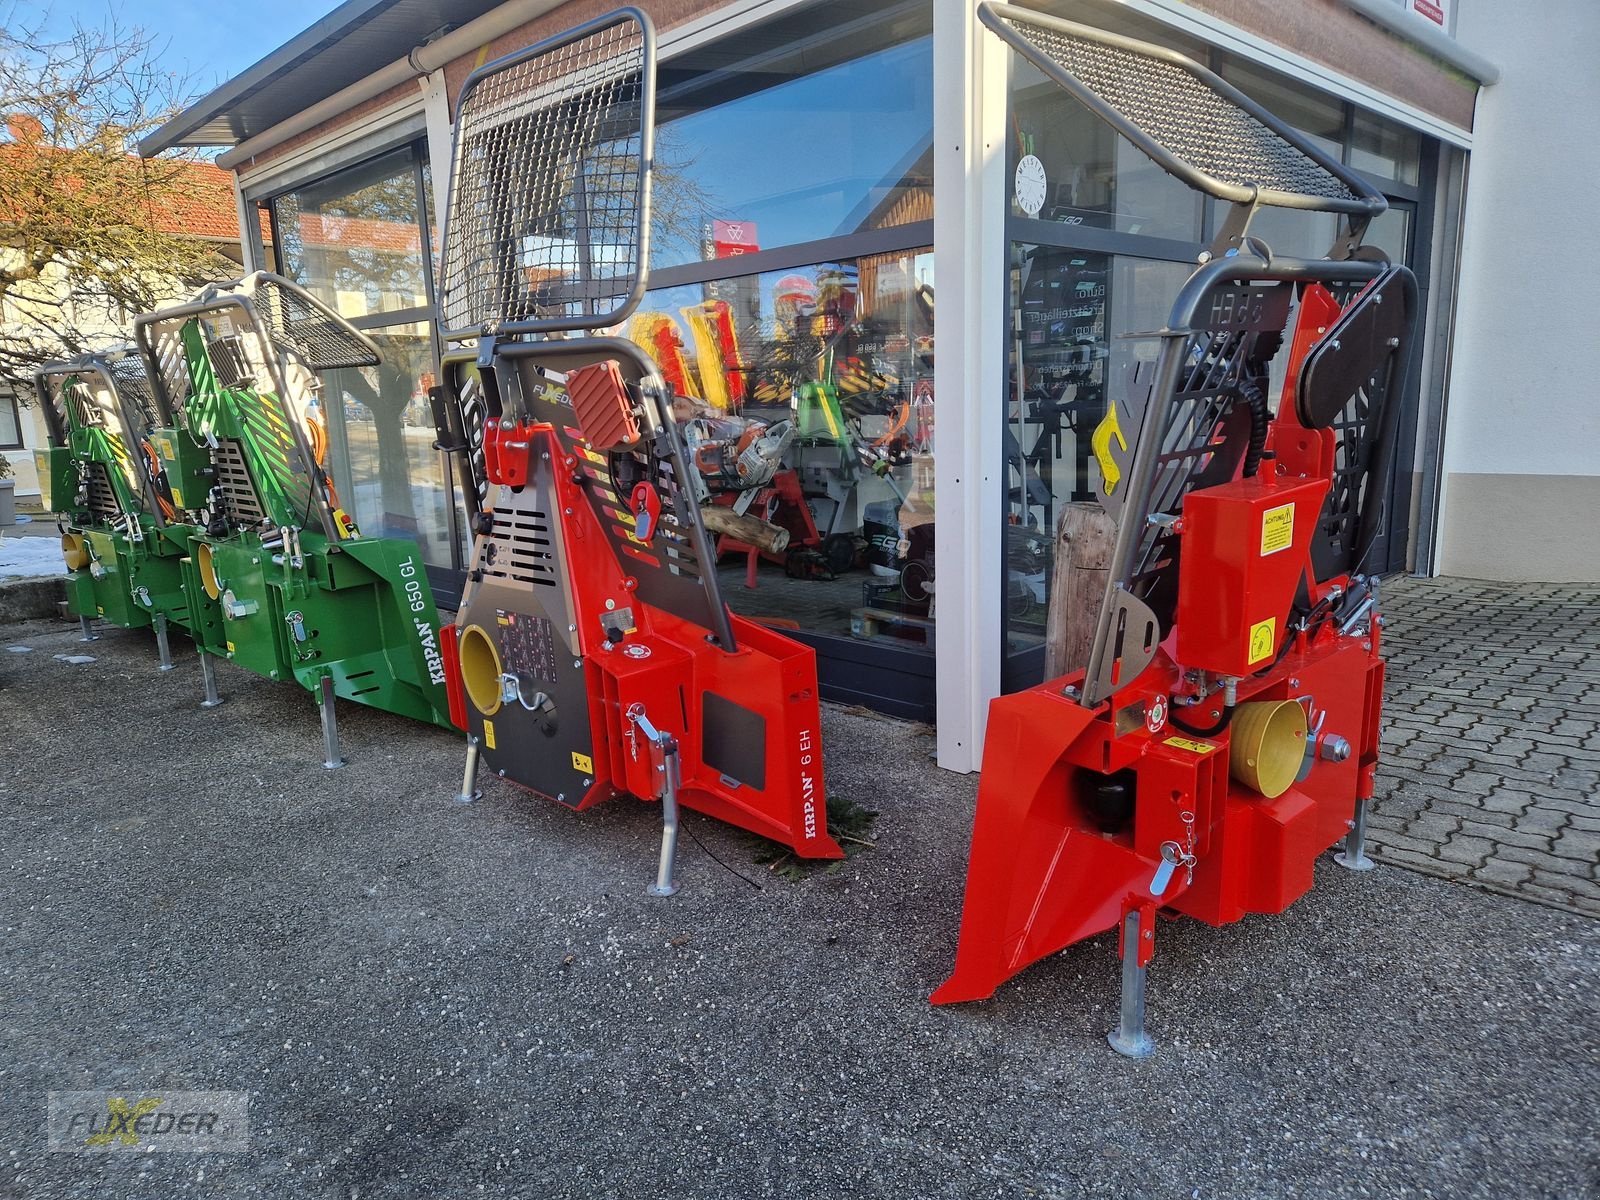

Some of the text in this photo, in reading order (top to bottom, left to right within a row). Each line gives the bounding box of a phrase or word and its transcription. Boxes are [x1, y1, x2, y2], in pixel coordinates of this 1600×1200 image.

[1018, 158, 1045, 180] MEISTER
[1056, 214, 1084, 226] EGO
[871, 533, 912, 553] EGO
[398, 556, 446, 686] KRPAN 650 GL
[799, 729, 817, 840] KRPAN 6 EH
